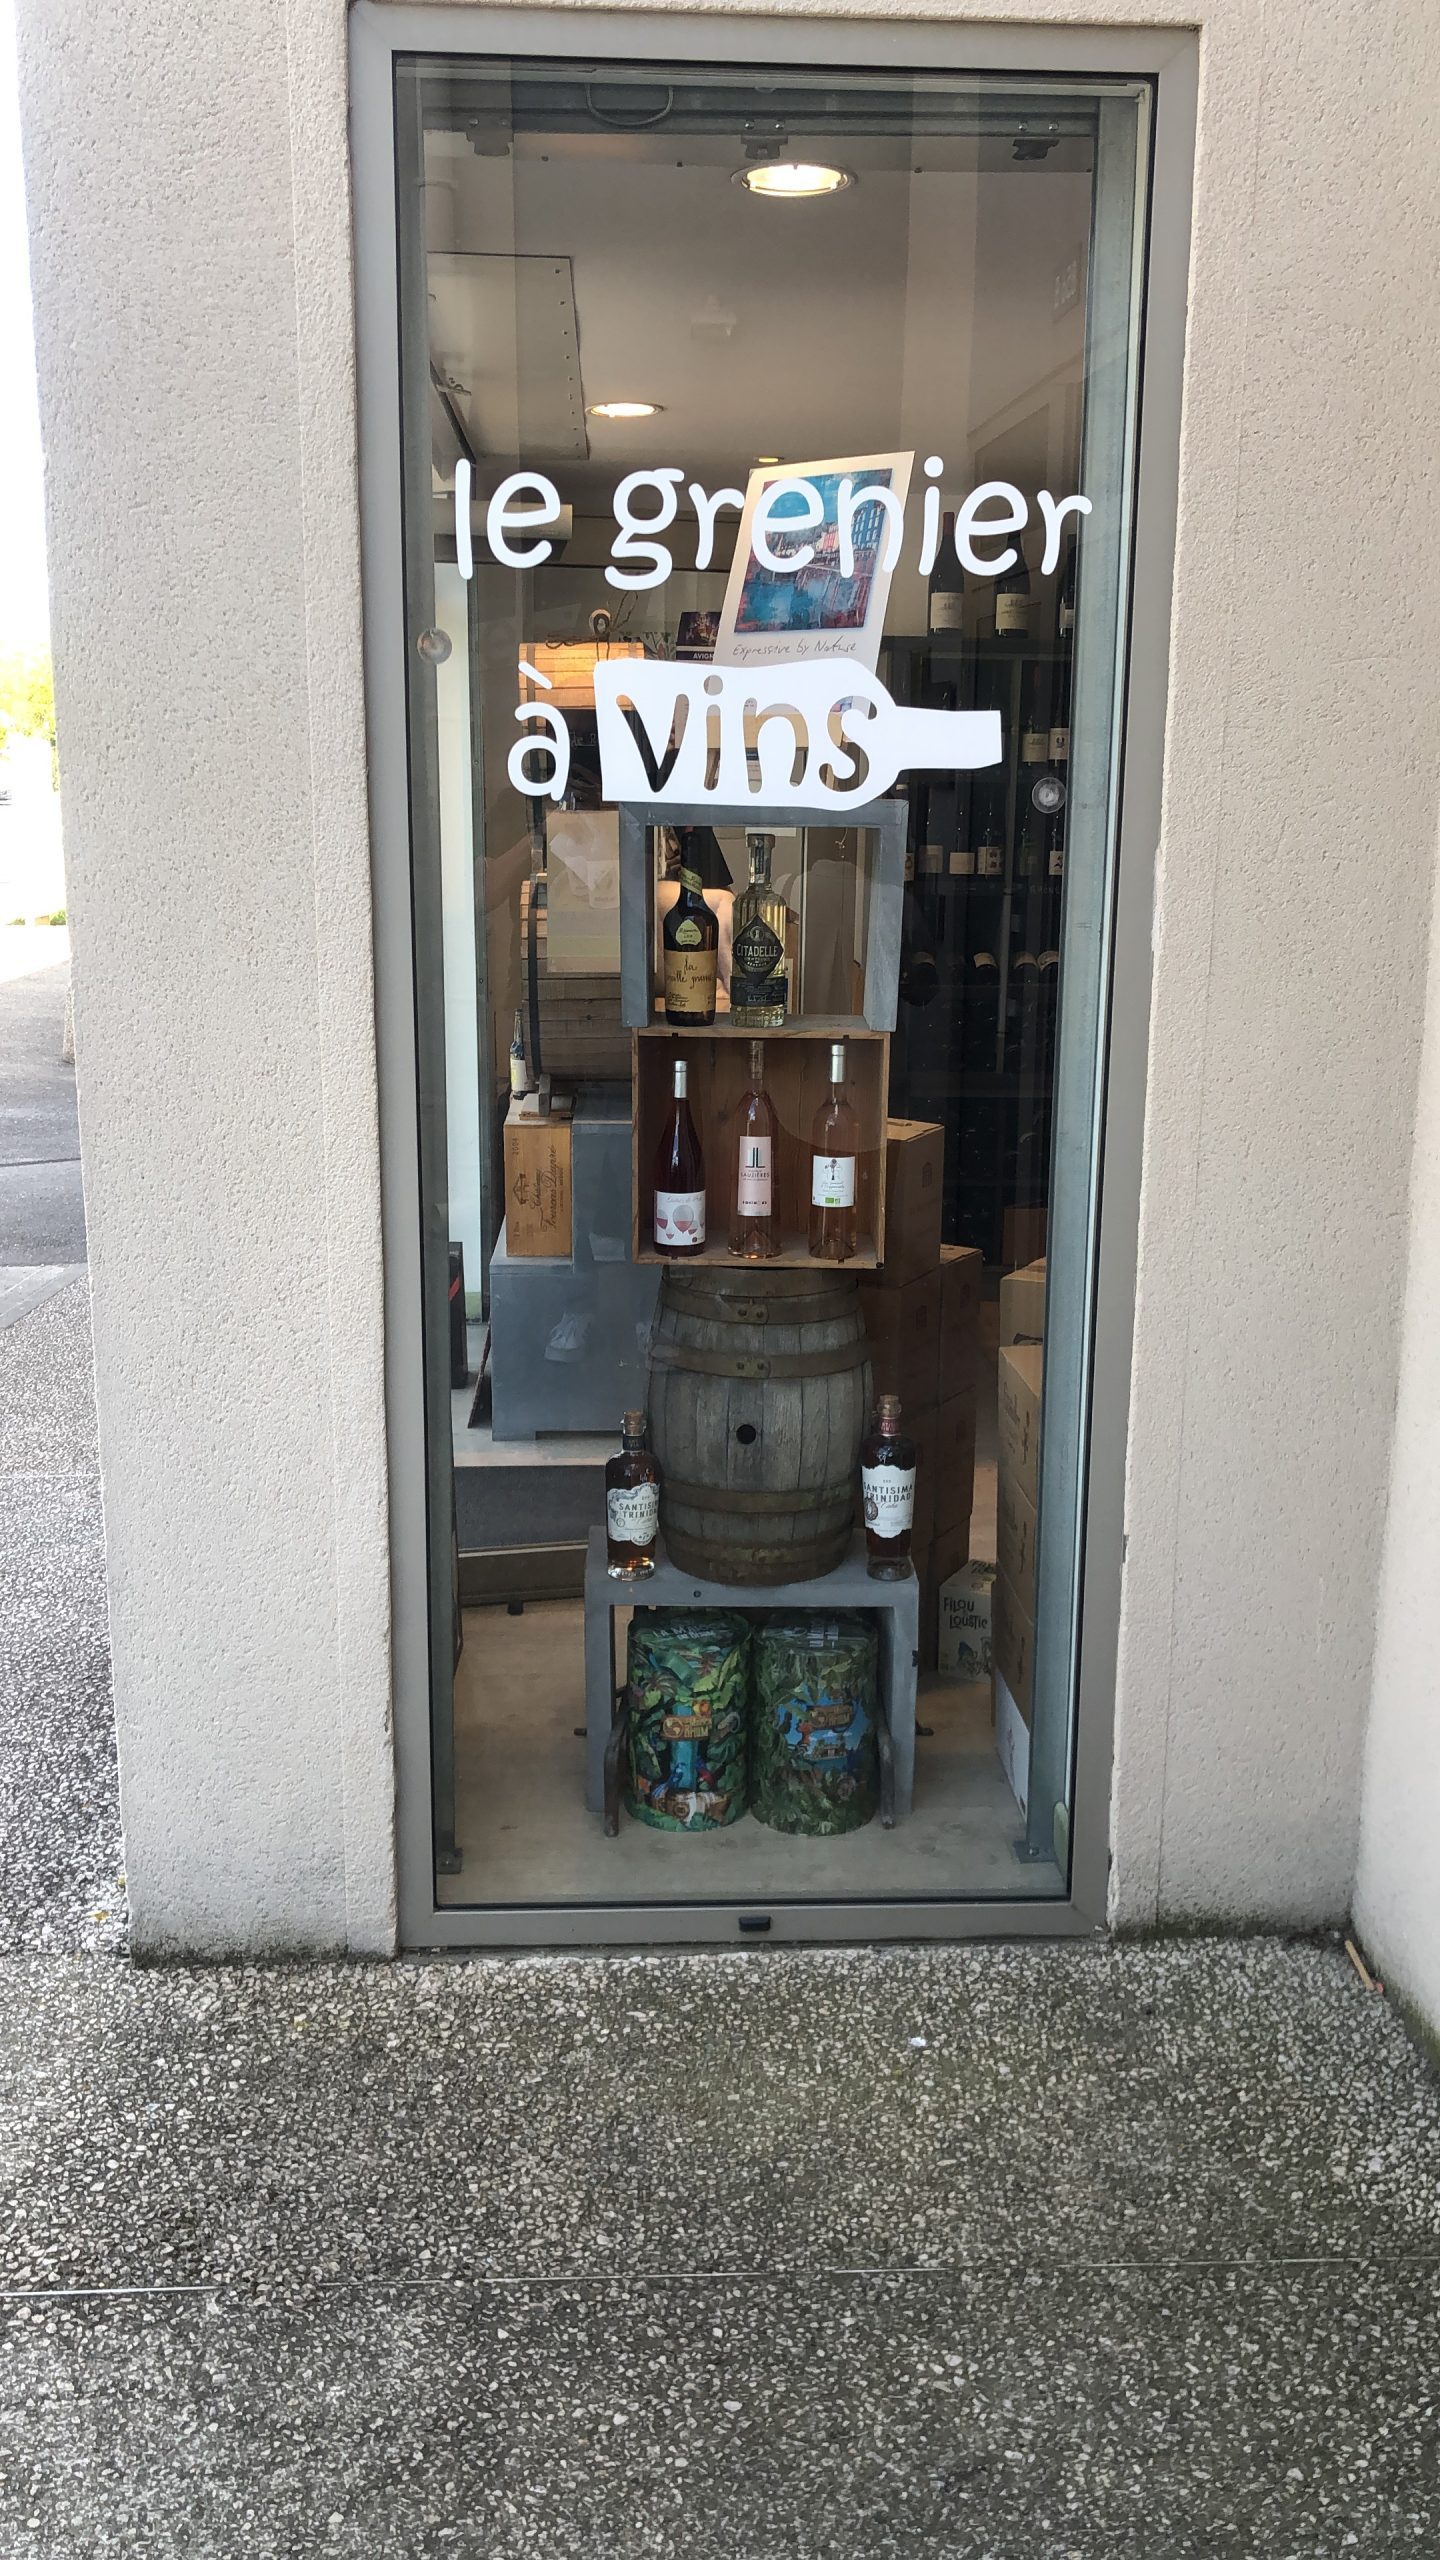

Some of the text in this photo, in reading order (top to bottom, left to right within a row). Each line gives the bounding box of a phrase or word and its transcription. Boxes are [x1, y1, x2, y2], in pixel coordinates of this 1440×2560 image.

[455, 455, 1093, 591] le grenier
[732, 642, 790, 660] Expressive
[797, 638, 810, 656] by
[506, 660, 879, 801] à vins
[737, 943, 779, 958] CITADELLE
[863, 1481, 913, 1495] SANTISIMA
